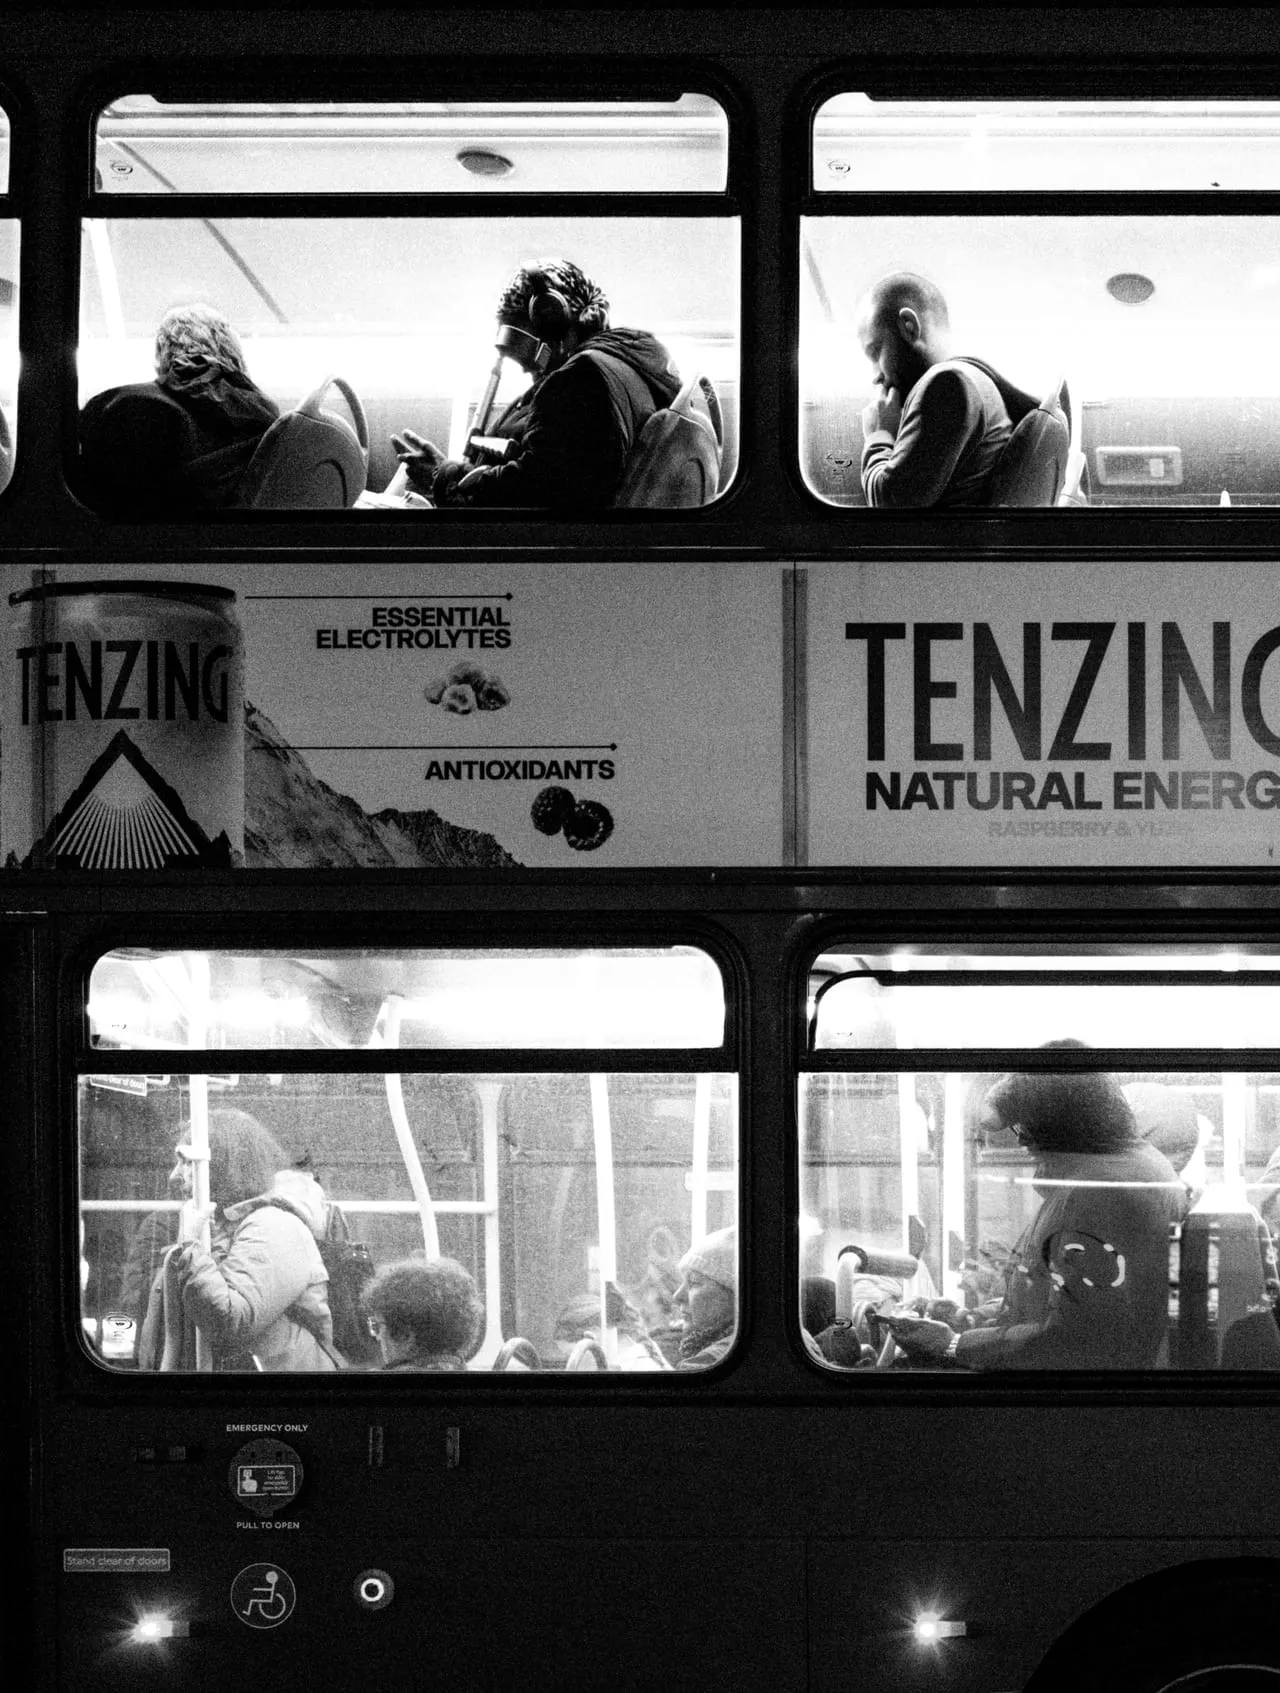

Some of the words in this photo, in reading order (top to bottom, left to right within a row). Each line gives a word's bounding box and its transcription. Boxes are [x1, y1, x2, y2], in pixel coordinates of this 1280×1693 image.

[371, 607, 510, 627] ESSENTIAL
[316, 628, 512, 649] ELECTROLYTES
[16, 640, 233, 726] TENZING
[425, 759, 616, 780] ANTIOXIDANTS
[866, 771, 1102, 810] NATURAL
[989, 821, 1113, 838] RASPBERRY
[226, 1424, 283, 1432] EMERGENCY
[284, 1424, 309, 1432] ONLY
[236, 1521, 258, 1529] PULL
[260, 1521, 273, 1529] TO
[274, 1521, 300, 1529] OPEN
[66, 1556, 96, 1566] Stand
[97, 1555, 122, 1566] clear
[124, 1556, 136, 1566] of
[137, 1556, 167, 1566] doors
